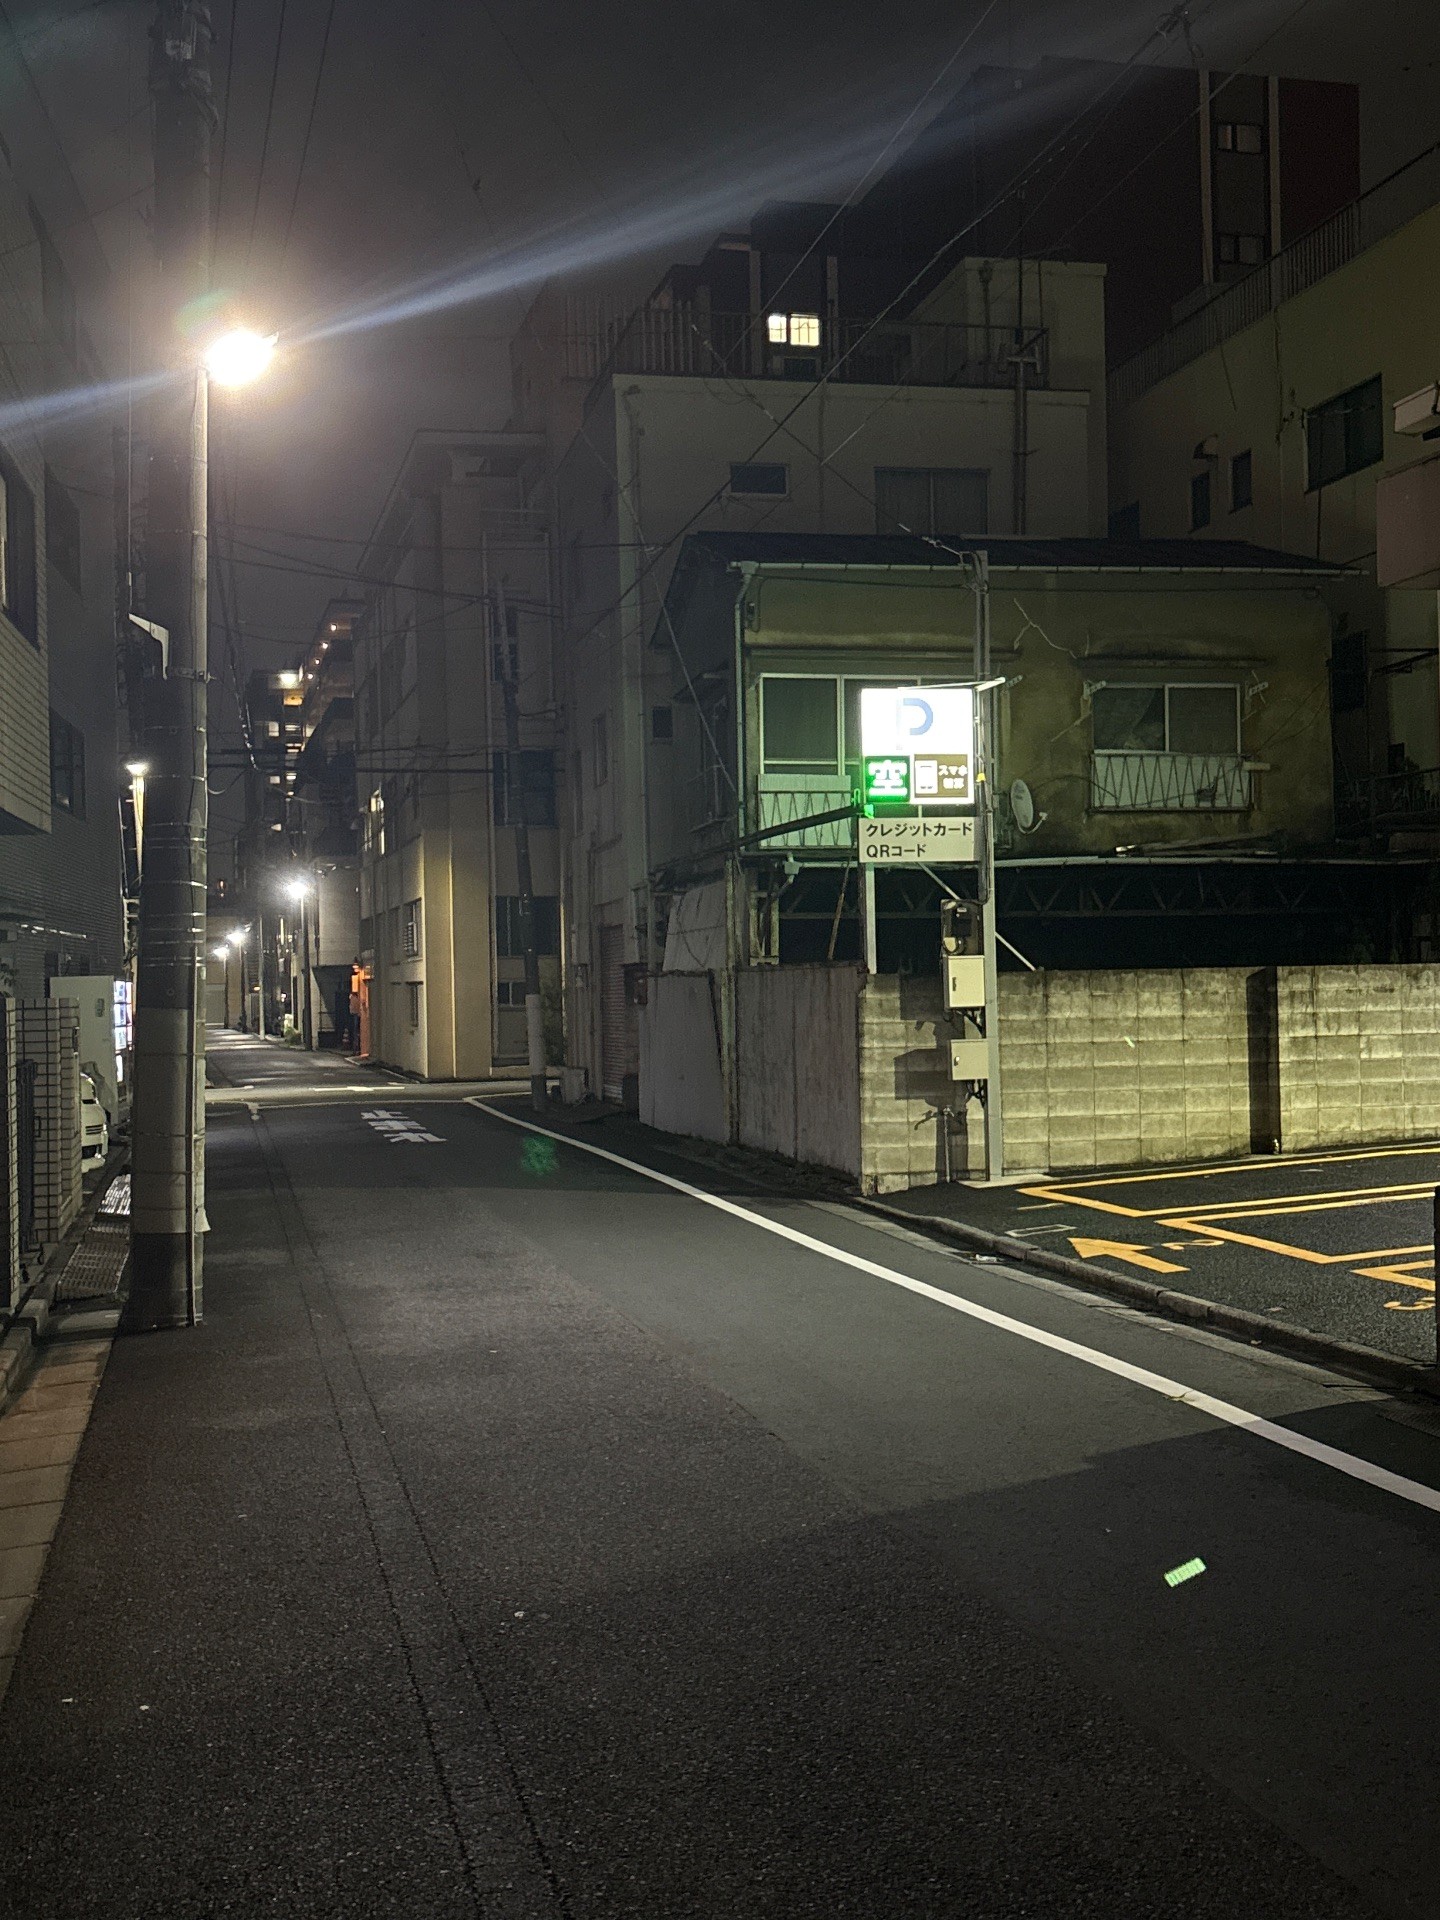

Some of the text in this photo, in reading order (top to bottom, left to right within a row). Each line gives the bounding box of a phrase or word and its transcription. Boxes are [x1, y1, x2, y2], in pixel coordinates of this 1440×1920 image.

[866, 822, 973, 838] クレジットカード
[866, 844, 927, 858] QRコード
